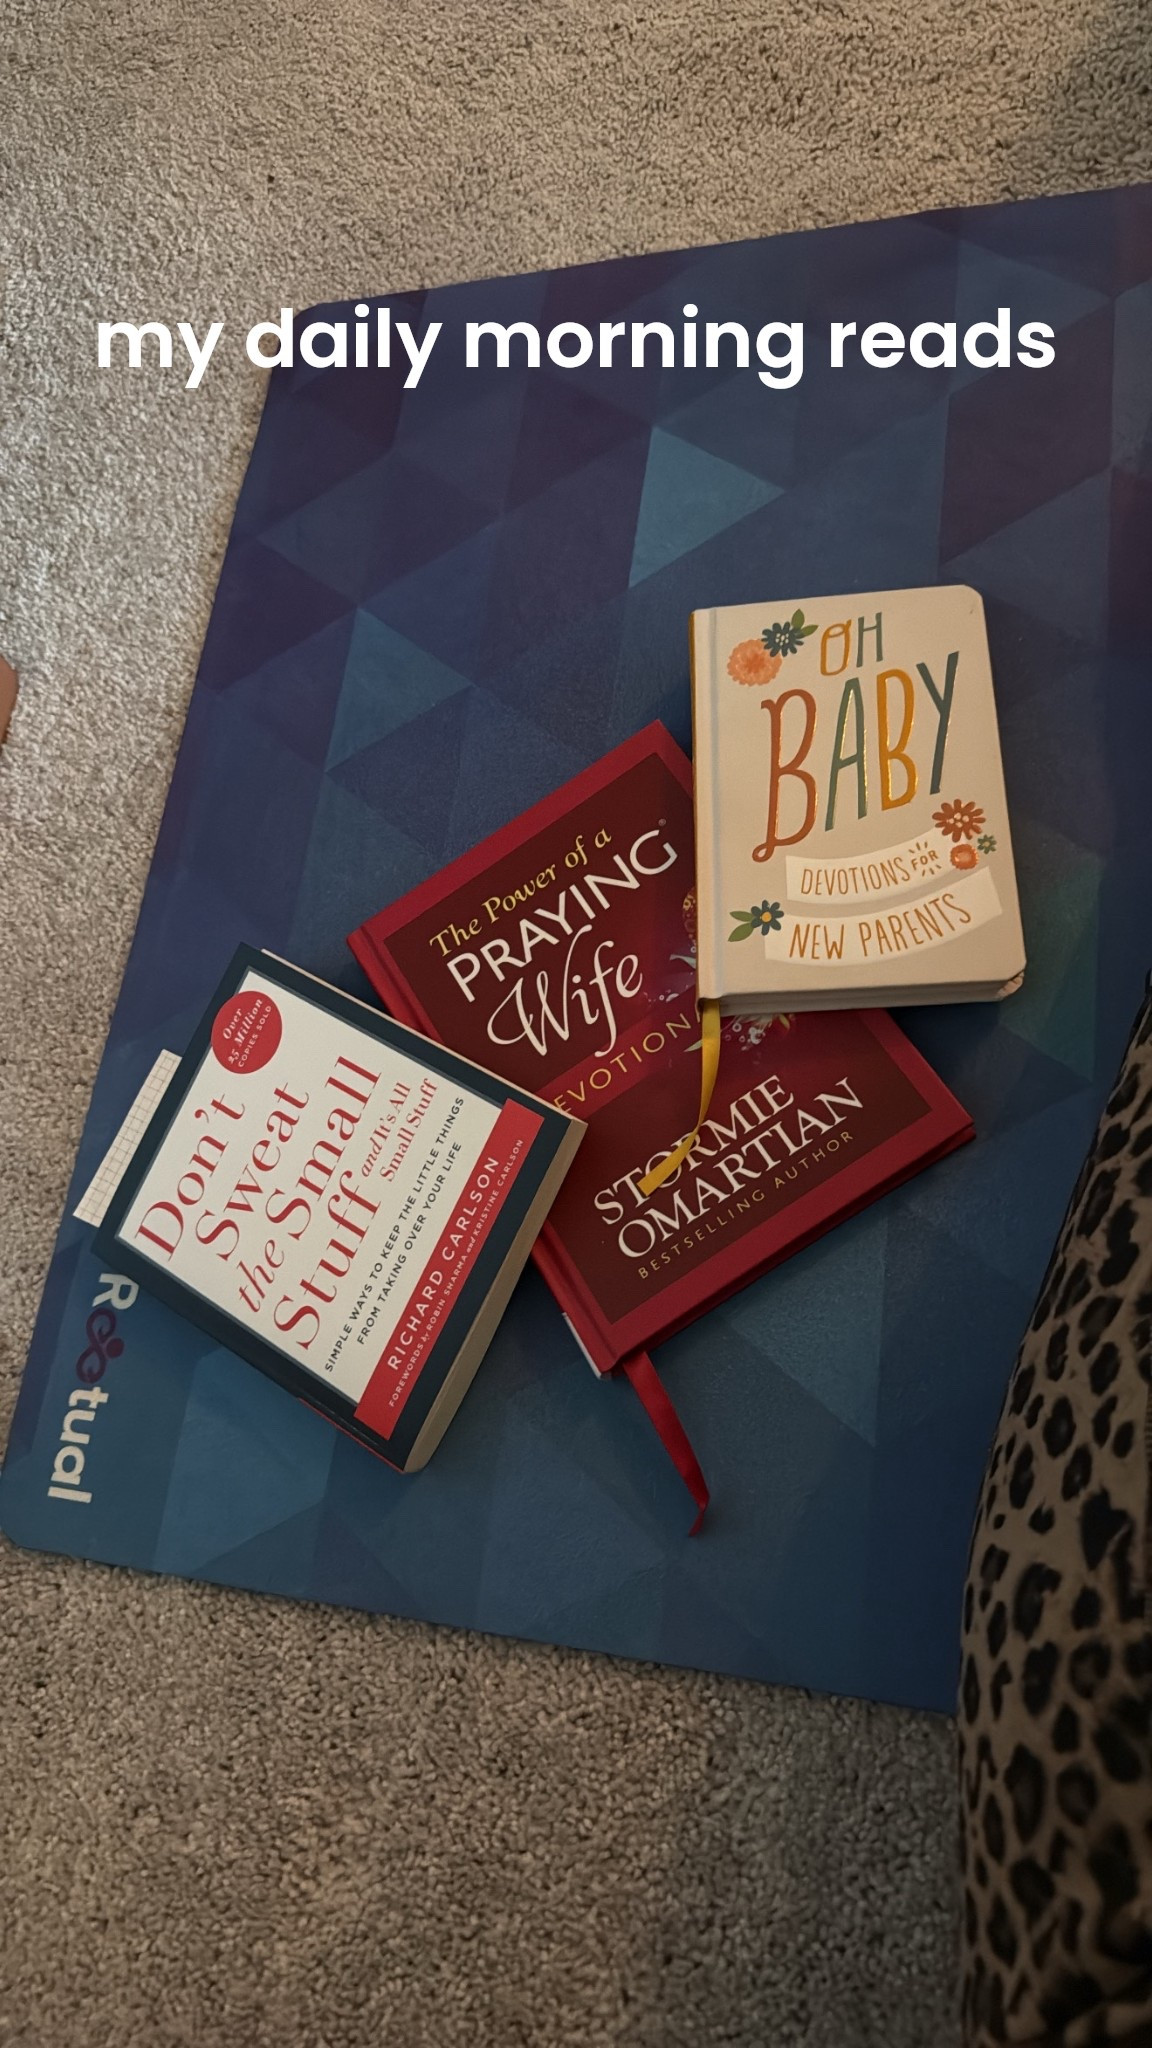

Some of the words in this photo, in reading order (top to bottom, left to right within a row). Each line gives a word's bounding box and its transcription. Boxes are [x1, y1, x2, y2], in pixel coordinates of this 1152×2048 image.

[820, 612, 884, 676] OH
[752, 651, 960, 863] BABY
[429, 918, 482, 956] The
[481, 863, 558, 924] Power
[564, 835, 588, 868] of
[594, 828, 612, 848] a
[789, 923, 844, 959] NEW
[858, 893, 971, 957] PARENTS
[801, 856, 910, 895] DEVOTIONS
[911, 850, 939, 871] FOR
[223, 1008, 242, 1039] Over
[234, 999, 262, 1047] Million
[238, 1034, 258, 1067] COPIES
[256, 1006, 271, 1030] SOLD
[487, 924, 643, 1057] Wife
[554, 1003, 701, 1114] EVOTION
[195, 1082, 309, 1262] Sweat
[237, 1239, 284, 1313] the
[265, 1056, 381, 1241] Small
[361, 1137, 383, 1178] and
[389, 1082, 411, 1114] All
[379, 1127, 415, 1182] Small
[406, 1078, 438, 1128] Stuff
[618, 1077, 863, 1258] OMARTIAN
[273, 1170, 381, 1350] Stuff
[325, 1324, 352, 1372] SIMPLE
[349, 1284, 373, 1320] WAYS
[370, 1262, 383, 1279] TO
[380, 1224, 400, 1259] KEEP
[399, 1195, 416, 1222] THE
[413, 1148, 440, 1193] LITTLE
[435, 1097, 464, 1145] THINGS
[357, 1306, 381, 1345] FROM
[378, 1254, 407, 1302] TAKING
[404, 1215, 427, 1250] OVER
[424, 1174, 446, 1210] YOUR
[445, 1141, 462, 1172] LIFE
[387, 1270, 443, 1370] RICHARD
[442, 1157, 499, 1261] CARLSON
[638, 1189, 766, 1279] BESTSELLING
[774, 1131, 853, 1188] AUTHOR
[389, 1343, 423, 1407] FOREWORDS
[427, 1300, 445, 1331] ROBIN
[443, 1255, 467, 1296] SHARMA
[466, 1237, 476, 1253] and
[474, 1189, 499, 1236] KRISTINE
[497, 1139, 524, 1187] CARLSON
